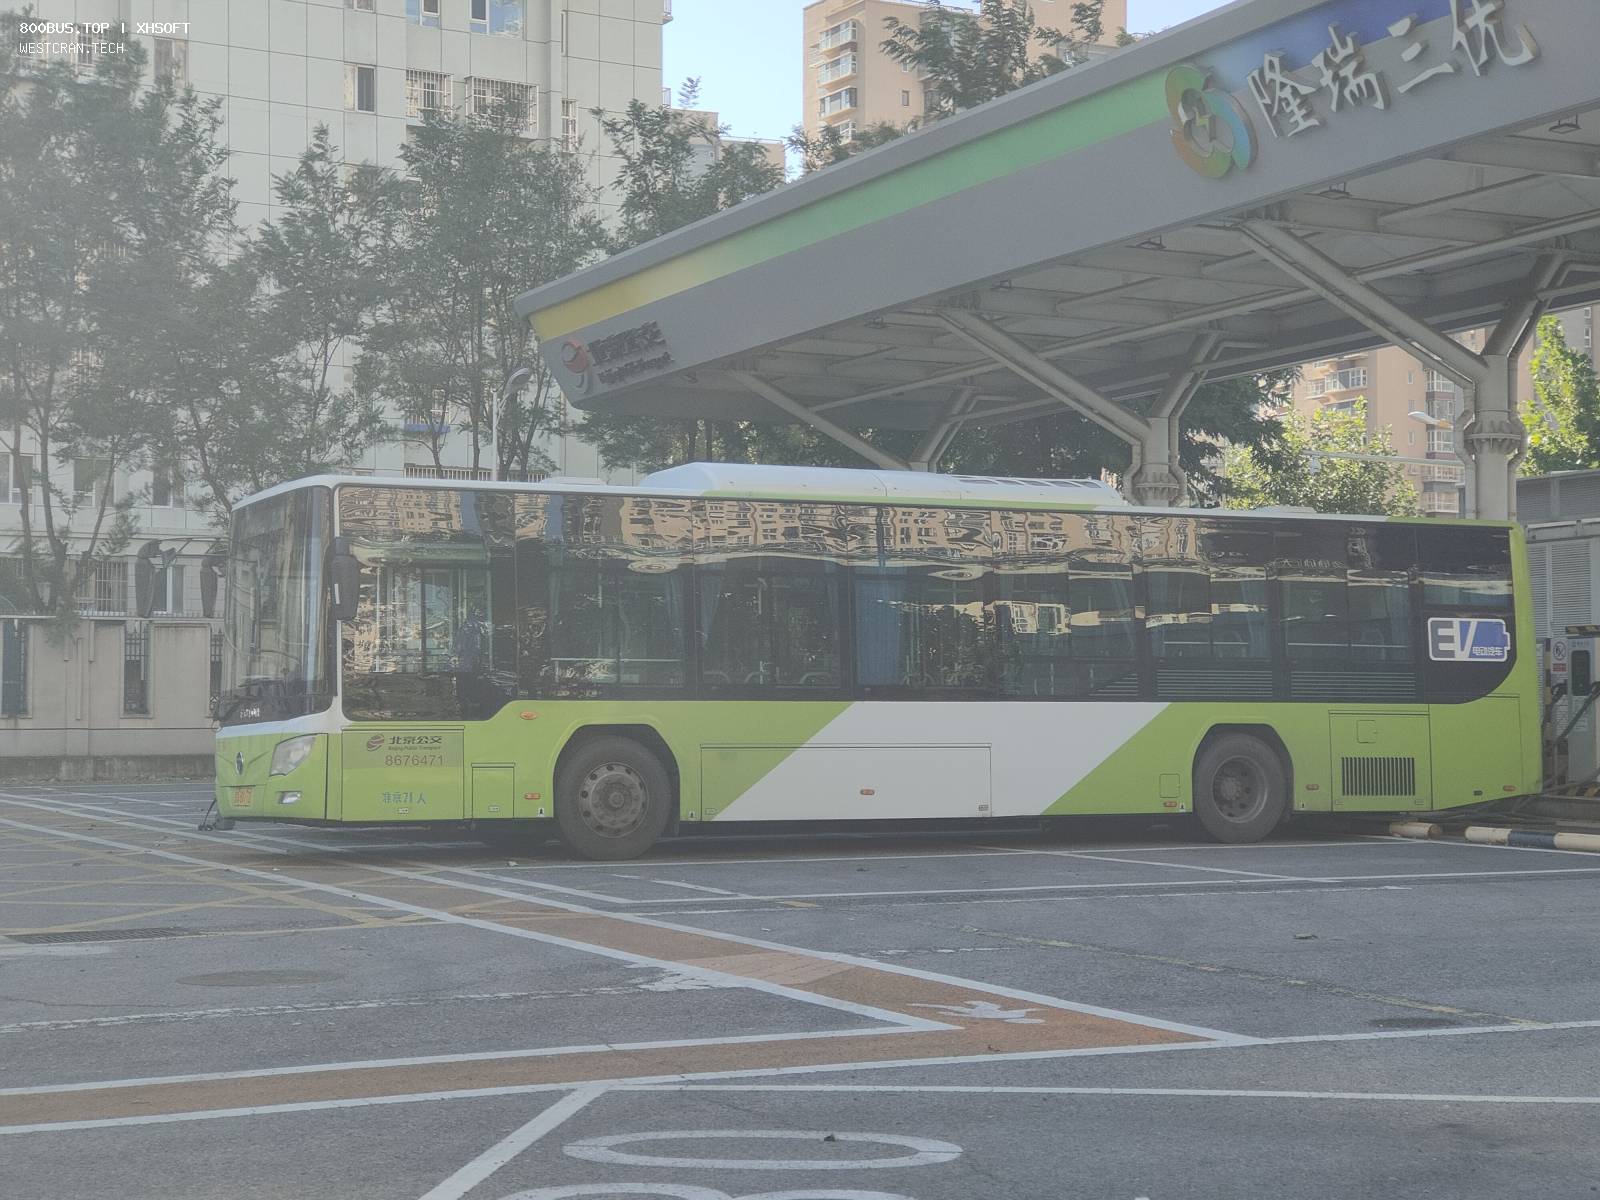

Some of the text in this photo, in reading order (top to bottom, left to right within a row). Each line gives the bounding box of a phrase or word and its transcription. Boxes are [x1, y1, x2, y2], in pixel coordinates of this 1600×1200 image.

[388, 736, 442, 745] 北京公交
[385, 755, 443, 766] 8676471
